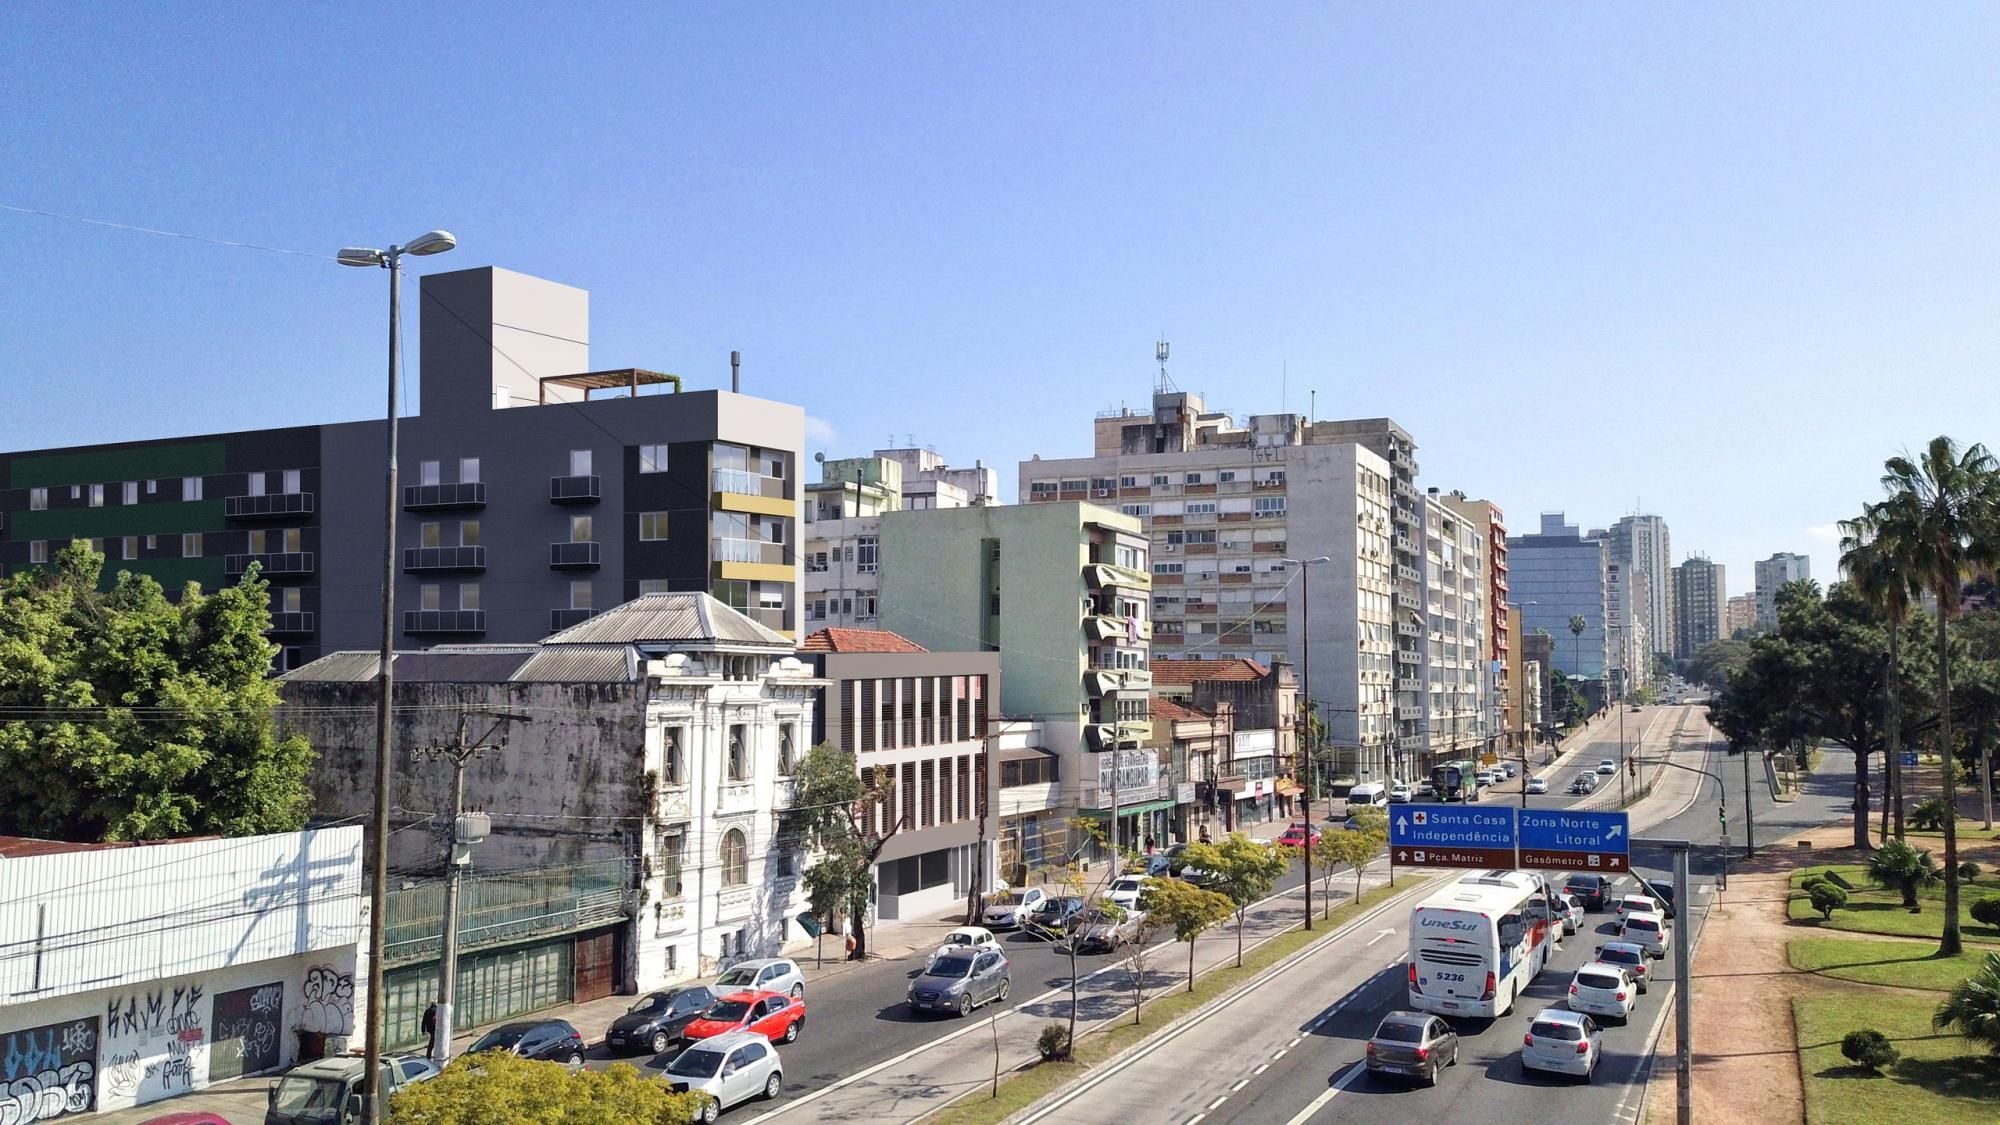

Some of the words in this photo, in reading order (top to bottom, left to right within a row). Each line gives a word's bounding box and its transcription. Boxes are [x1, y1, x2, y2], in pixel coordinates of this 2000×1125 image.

[1431, 813, 1469, 825] Santa
[1473, 814, 1506, 825] Casa
[1522, 815, 1556, 828] Zona
[1560, 817, 1600, 829] Norte
[1412, 829, 1510, 843] Independência
[1556, 833, 1600, 846] Litoral
[1429, 852, 1449, 863] Pça.
[1451, 853, 1484, 863] Matriz
[1525, 854, 1584, 866] Gasômetro
[1420, 917, 1478, 932] UneSul
[1436, 971, 1465, 983] 5236
